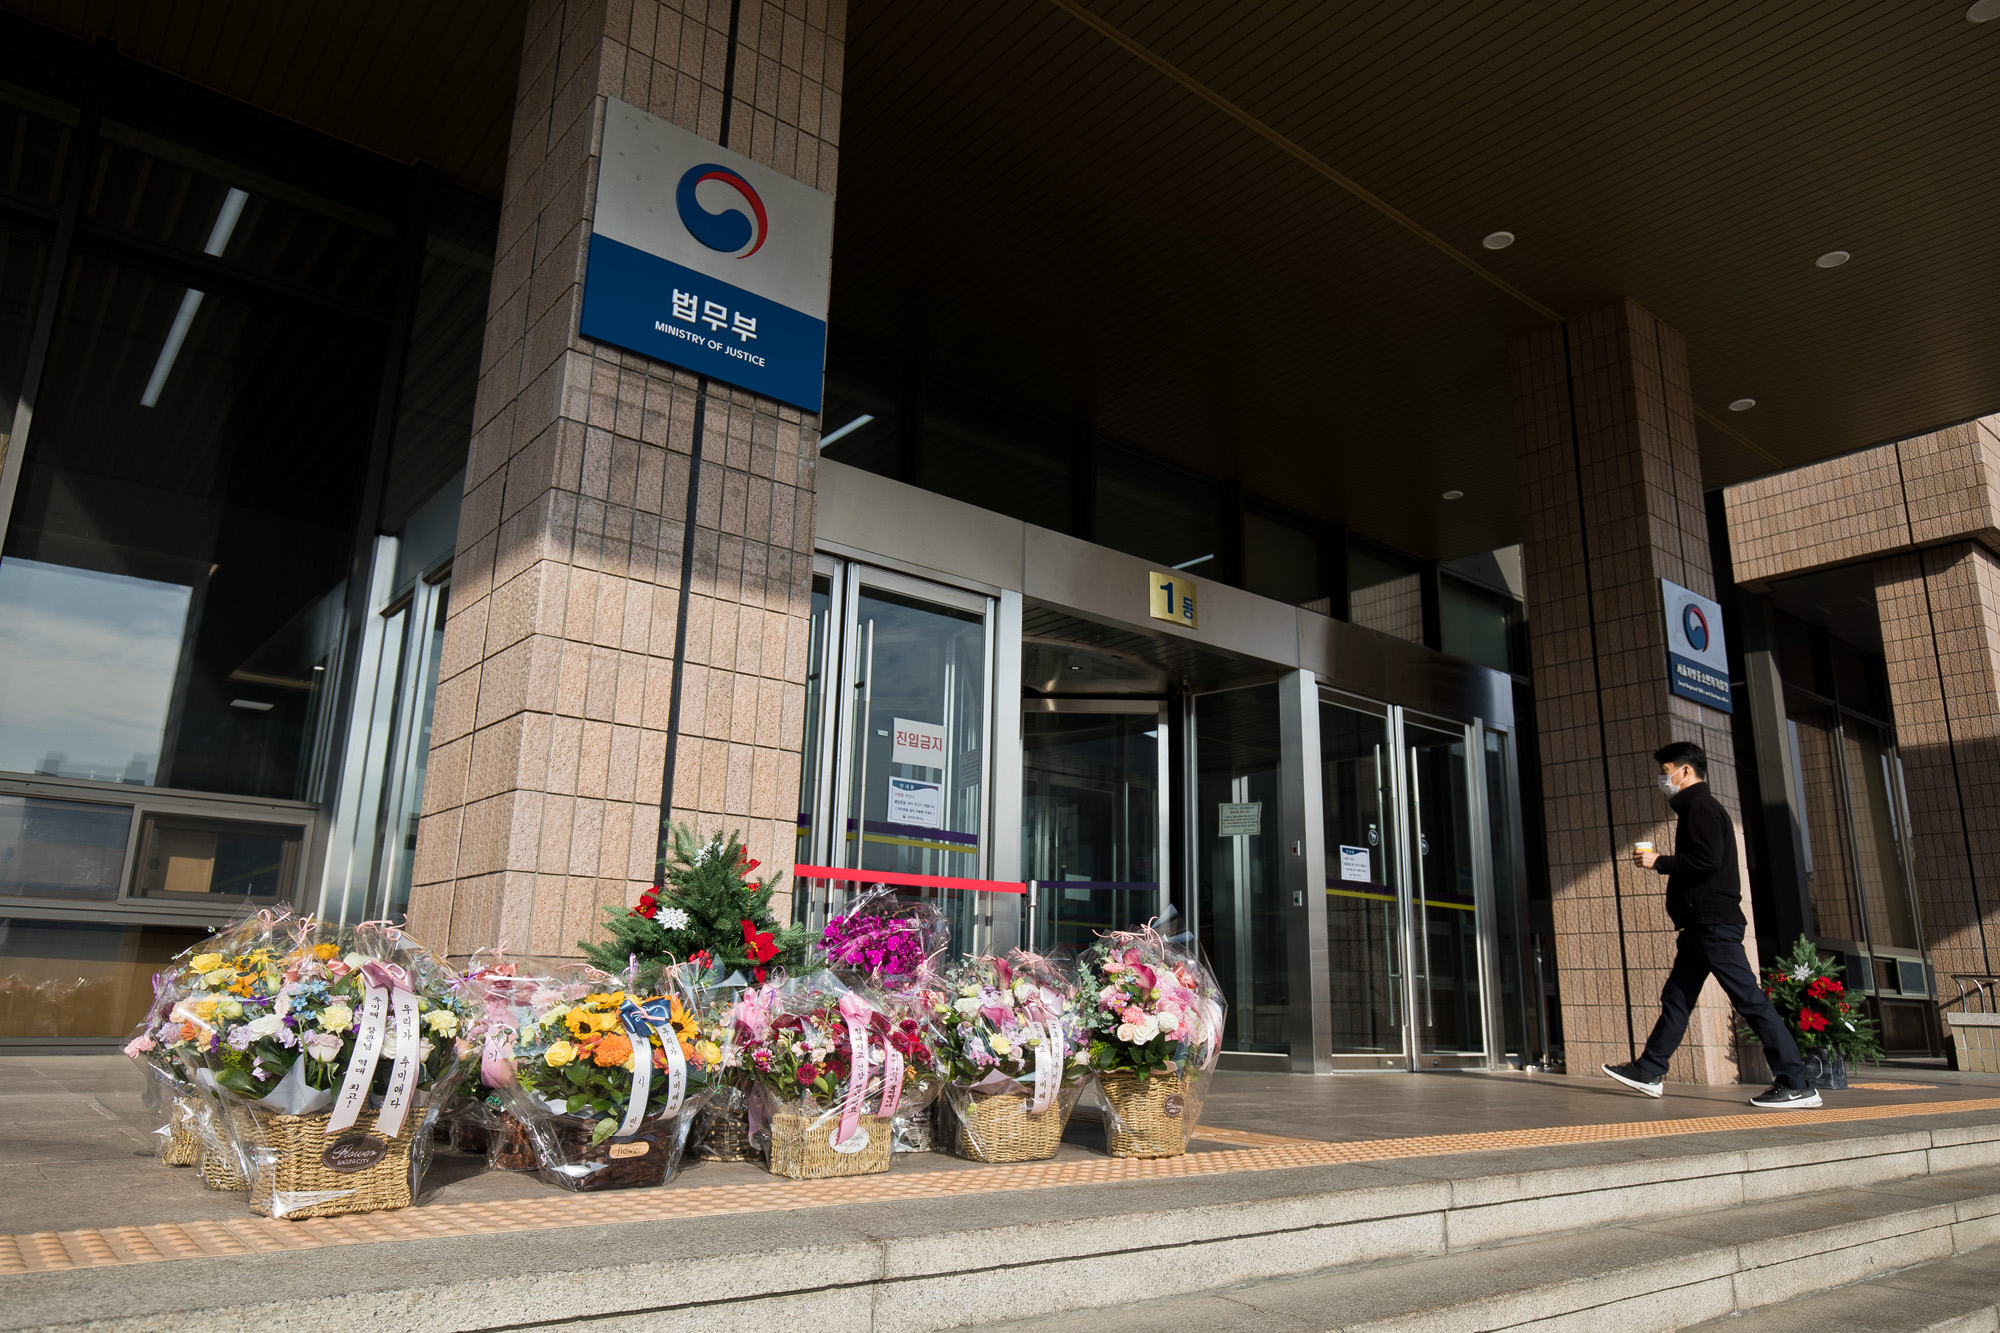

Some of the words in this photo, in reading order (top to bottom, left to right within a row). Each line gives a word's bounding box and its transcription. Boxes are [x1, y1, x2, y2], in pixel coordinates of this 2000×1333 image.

[672, 288, 757, 342] 법무부
[655, 320, 706, 346] MINISTRY
[707, 339, 723, 352] OF
[724, 345, 766, 367] JUSTICE
[896, 730, 943, 752] 진입금지
[363, 1026, 378, 1051] 장관님
[401, 1004, 413, 1041] 우리가
[662, 1027, 678, 1056] 우리가
[355, 1059, 368, 1076] 역대
[390, 1056, 410, 1110] 추미애다
[345, 1084, 360, 1108] 최고!
[669, 1069, 682, 1112] 추미애다
